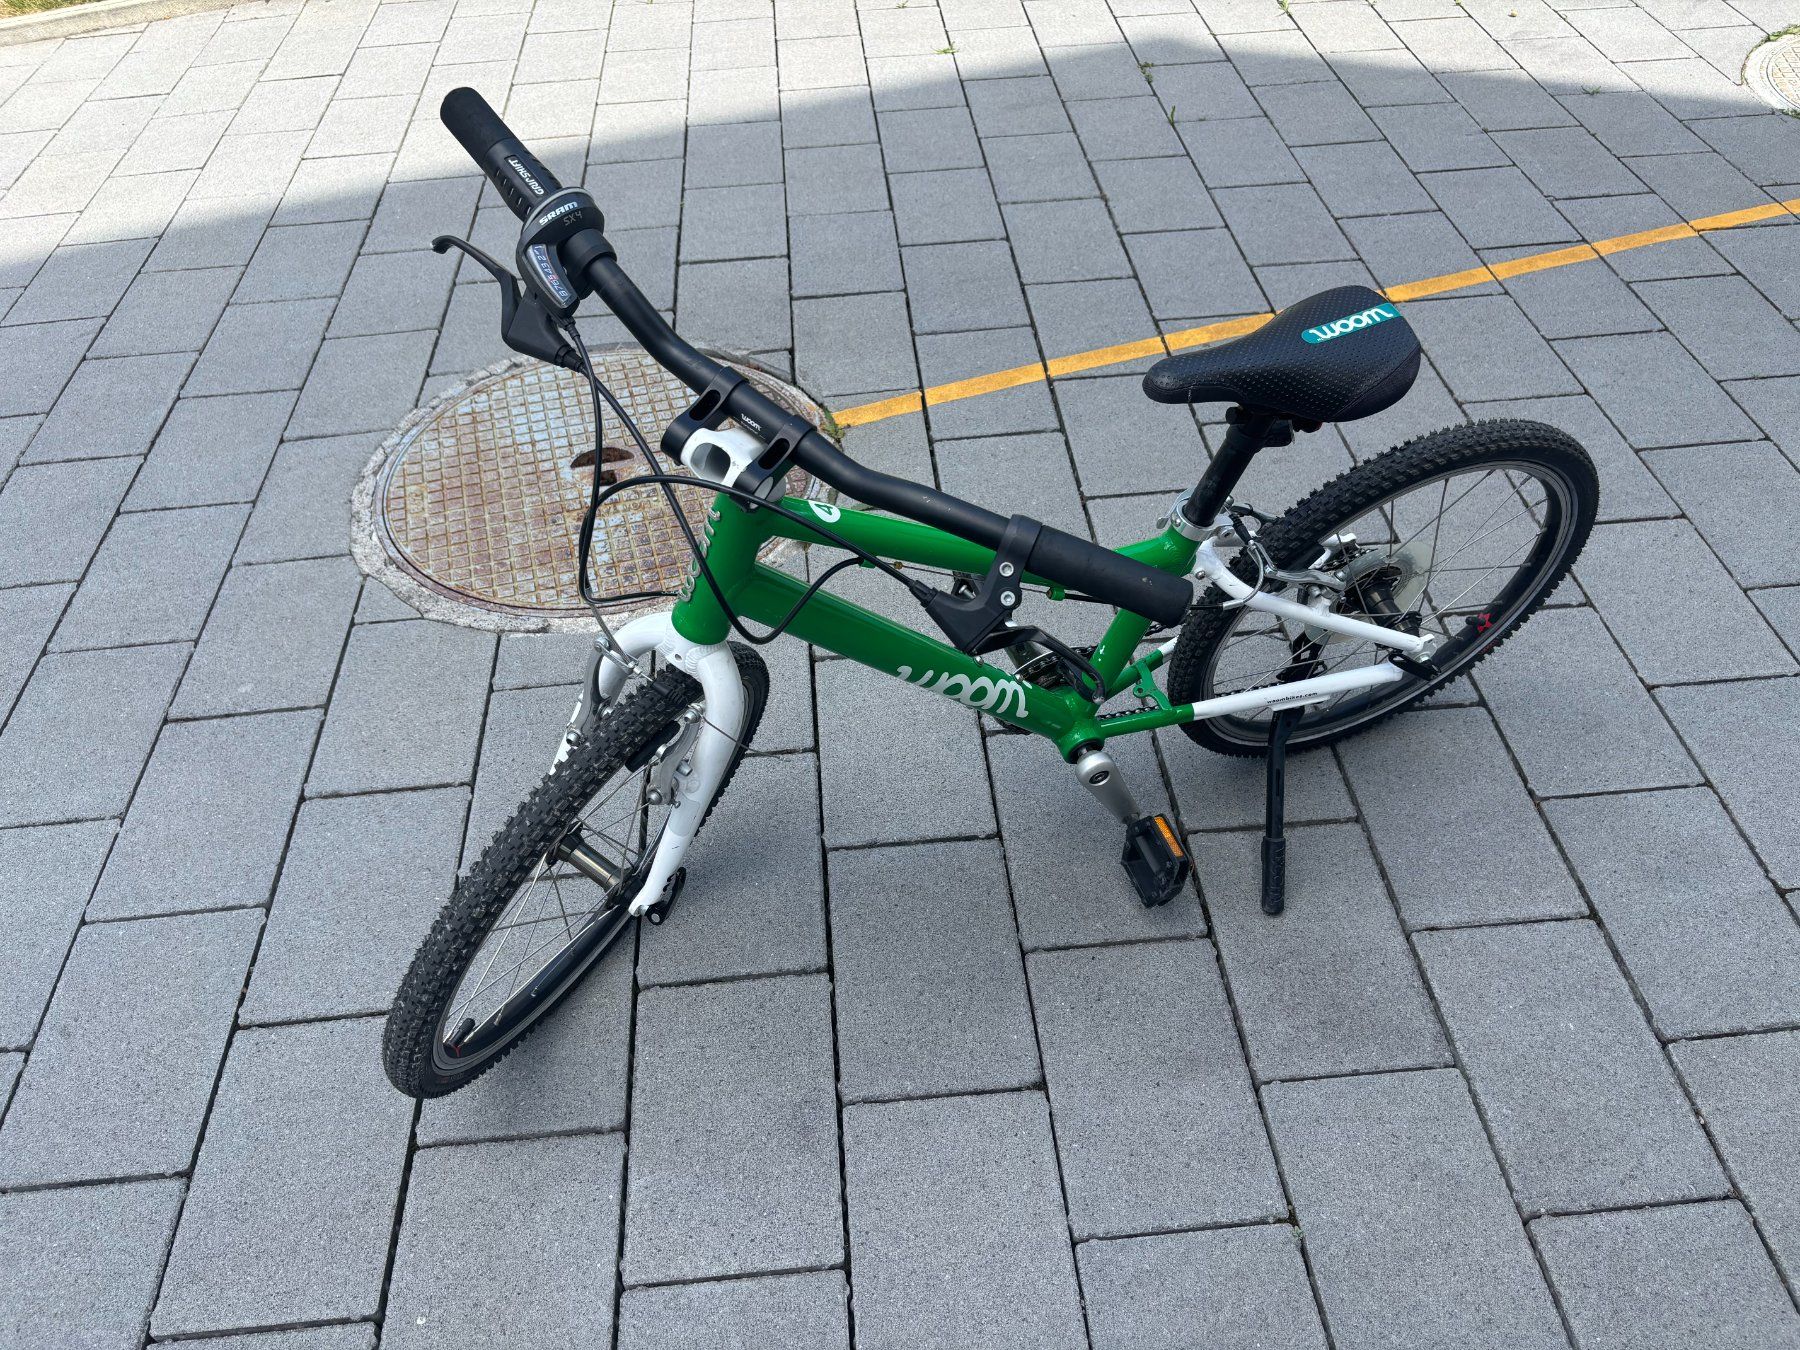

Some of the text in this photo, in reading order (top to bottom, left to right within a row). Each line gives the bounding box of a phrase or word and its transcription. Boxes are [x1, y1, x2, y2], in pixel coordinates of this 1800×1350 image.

[508, 159, 531, 178] SHIFT
[538, 201, 578, 226] SRAM
[563, 210, 582, 226] SX4
[1309, 308, 1393, 339] woom
[741, 413, 761, 431] woom
[813, 502, 833, 516] 4
[896, 665, 1029, 718] woom
